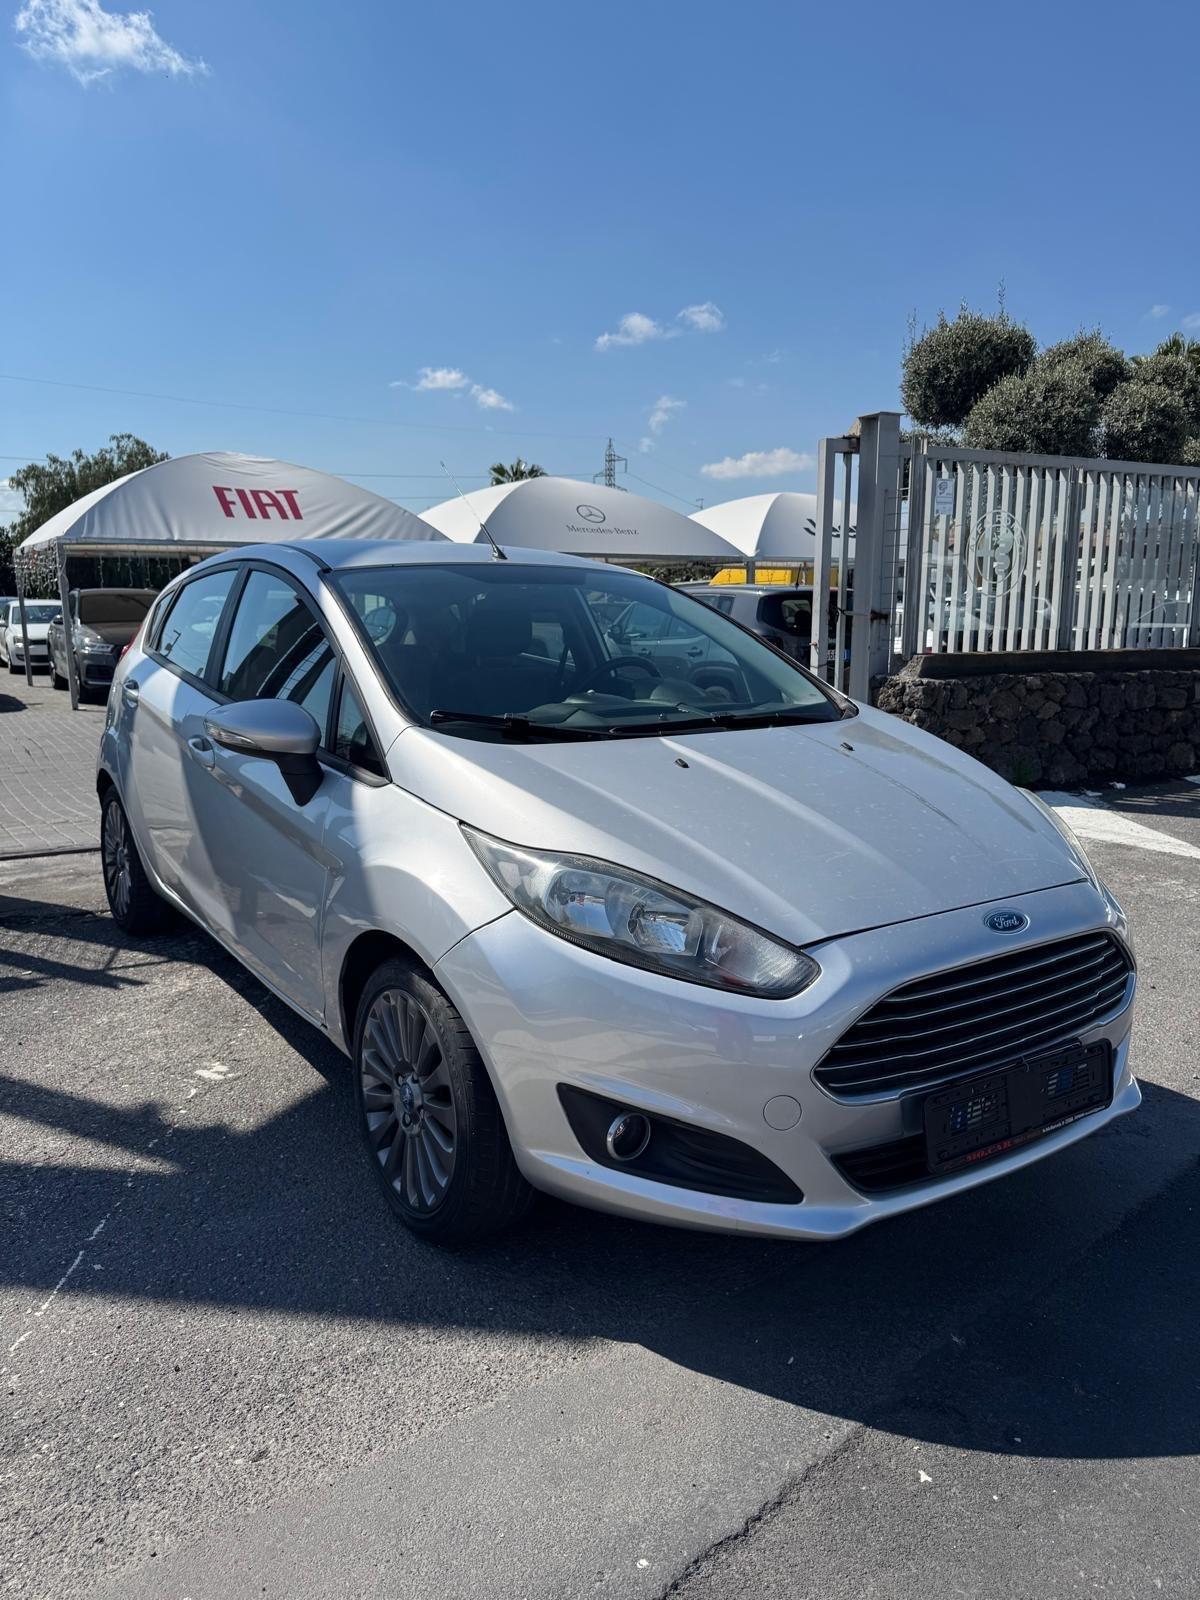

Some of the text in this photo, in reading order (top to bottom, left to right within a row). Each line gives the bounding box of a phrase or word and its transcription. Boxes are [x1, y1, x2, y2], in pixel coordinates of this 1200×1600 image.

[212, 485, 304, 520] FIAT
[565, 524, 640, 536] Mercedes-Benz
[993, 914, 1020, 929] Ford
